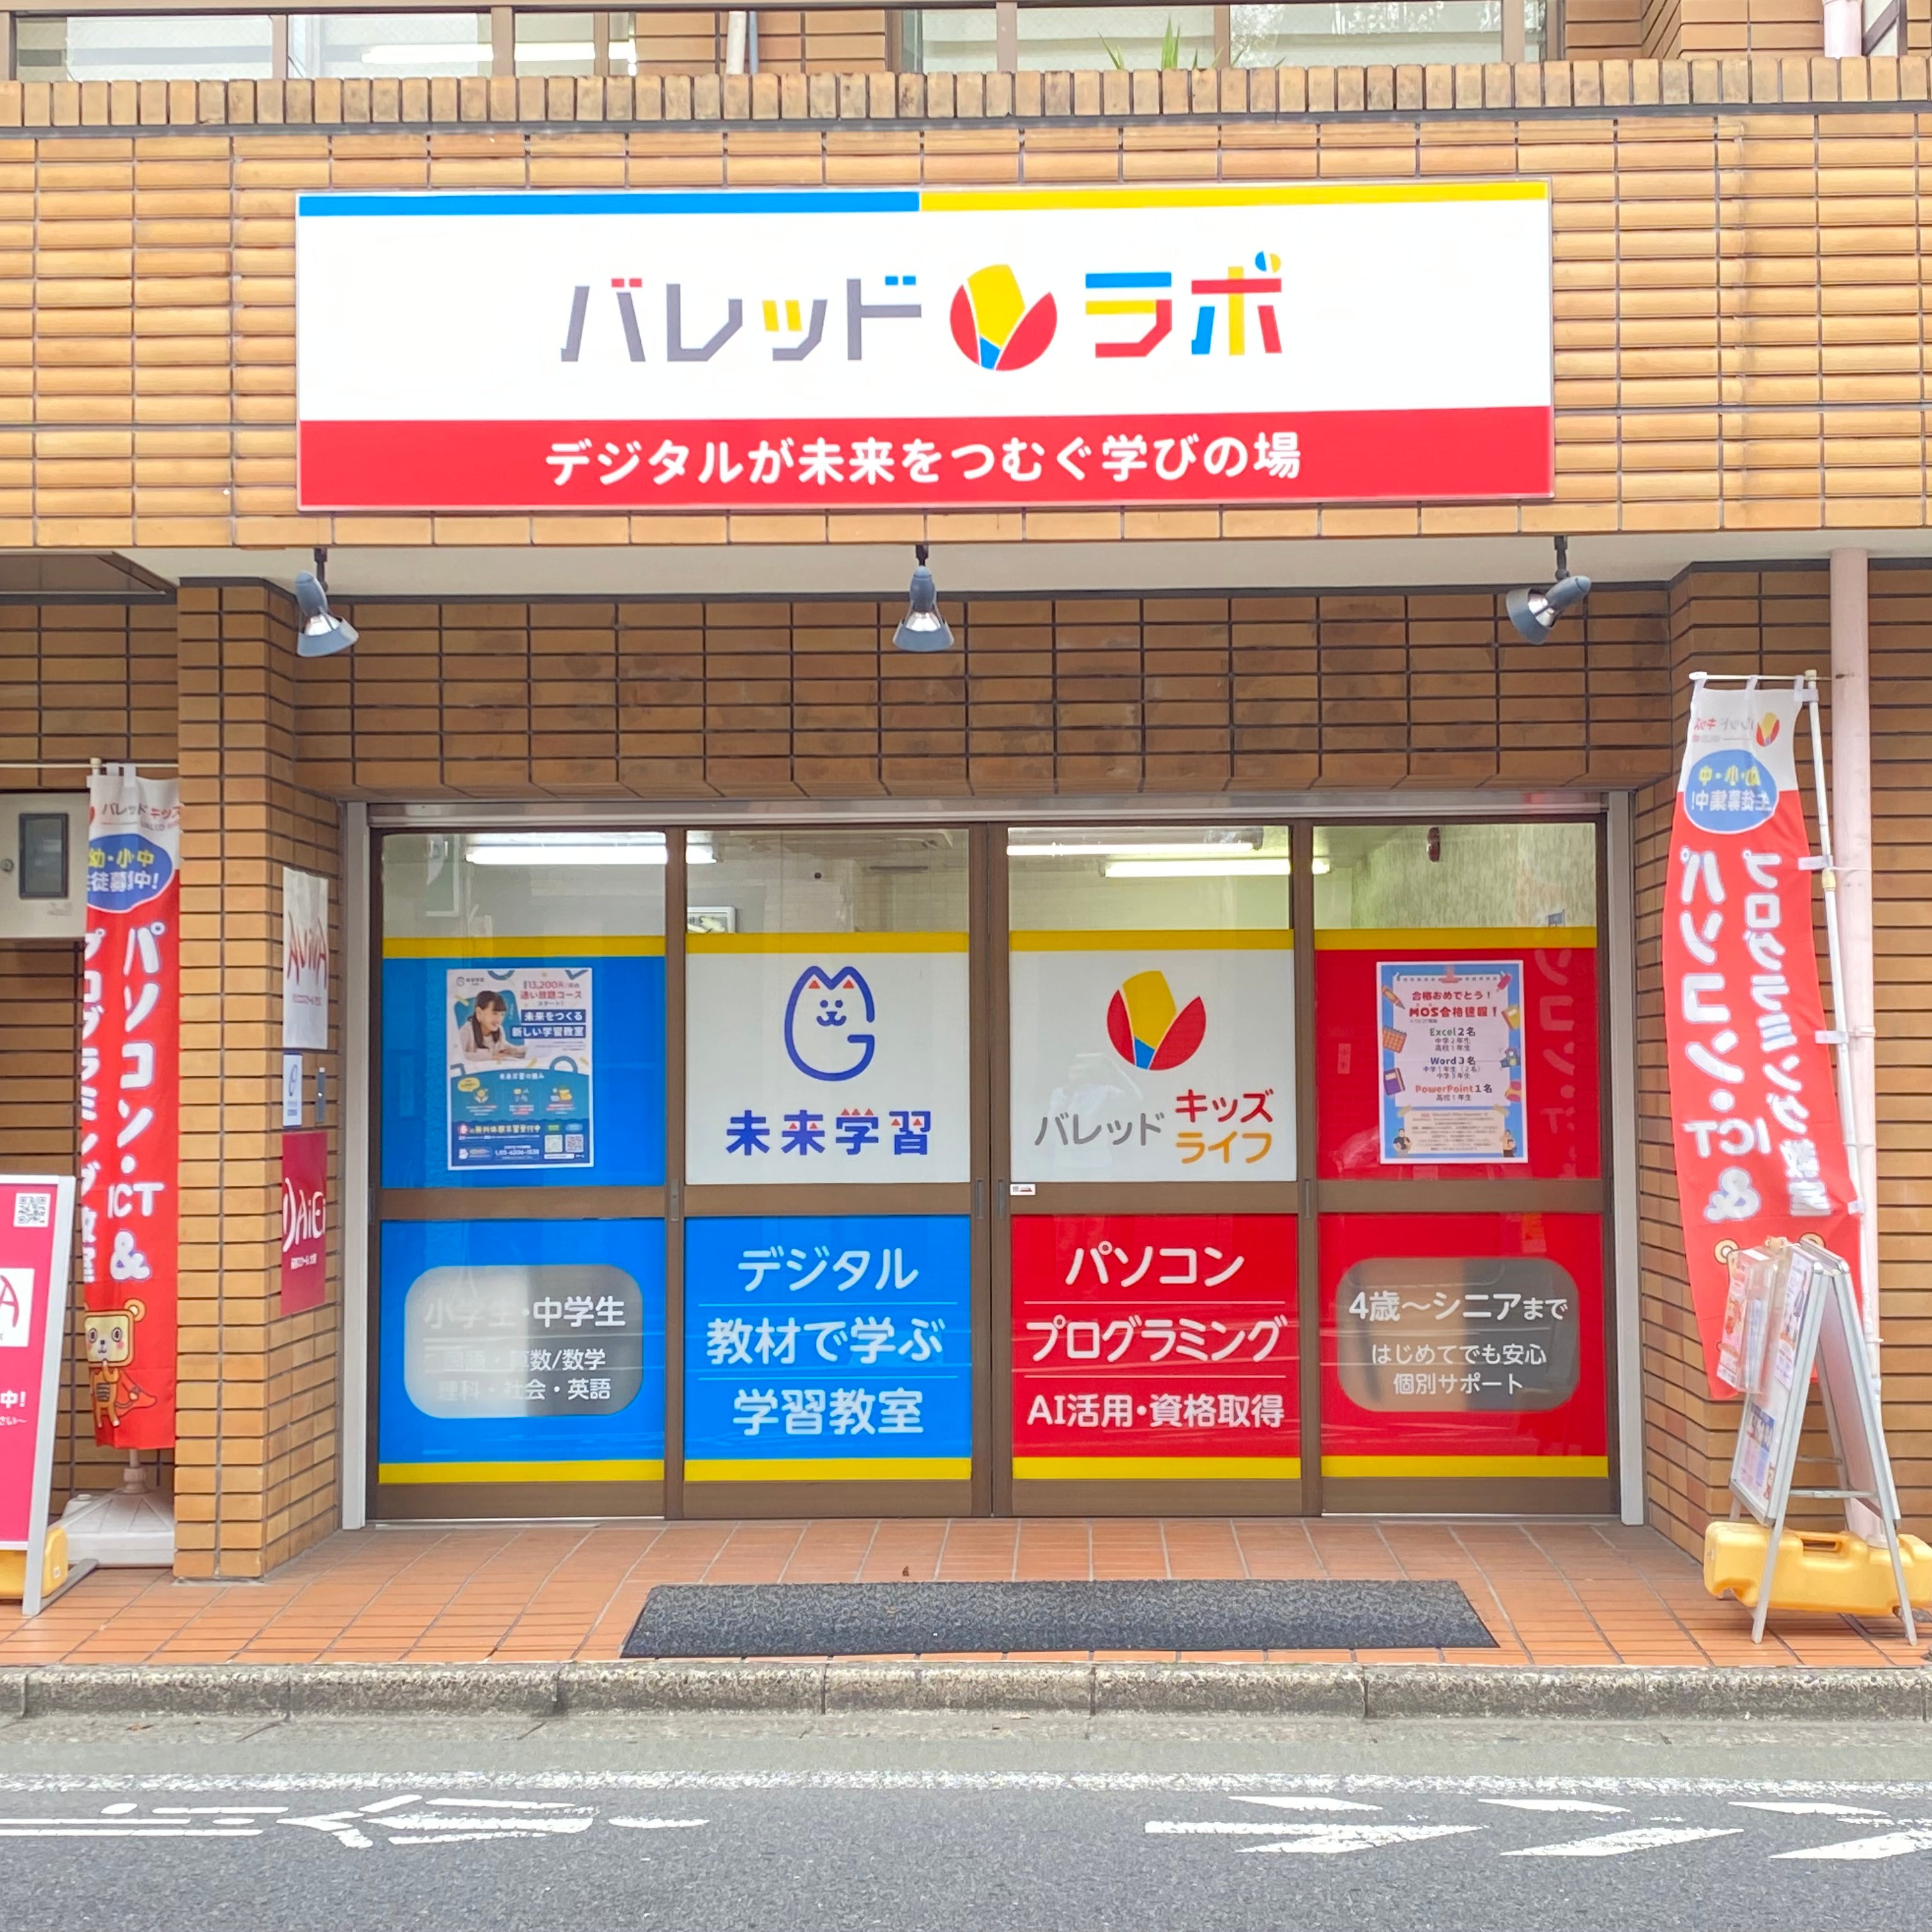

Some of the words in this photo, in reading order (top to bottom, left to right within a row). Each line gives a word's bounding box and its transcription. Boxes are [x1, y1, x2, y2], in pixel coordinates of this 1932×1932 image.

[561, 275, 921, 362] バレッド
[1085, 250, 1282, 357] ラボ
[545, 432, 1301, 484] デジタルが未来をつむぐ学びの場
[512, 1027, 584, 1038] 新しい学習教室
[525, 1011, 583, 1022] 未来をつくる
[1175, 1089, 1274, 1123] キッズ
[726, 1108, 931, 1156] 未来学習
[1034, 1112, 1165, 1146] バレッド
[1176, 1131, 1272, 1164] ライフ
[738, 1245, 919, 1292] デジタル
[1065, 1241, 1245, 1287] パソコン
[424, 1296, 626, 1329] 小学生・中学生
[707, 1316, 946, 1365] 教材で学ぶ
[1026, 1314, 1288, 1362] プログラミング
[1372, 1344, 1547, 1366] はじめてでも安心
[438, 1377, 611, 1400] 理科・社会・英語
[1393, 1372, 1523, 1395] 個別サポート
[733, 1388, 924, 1436] 学習教室
[1027, 1393, 1284, 1428] AI活用・資格取得
